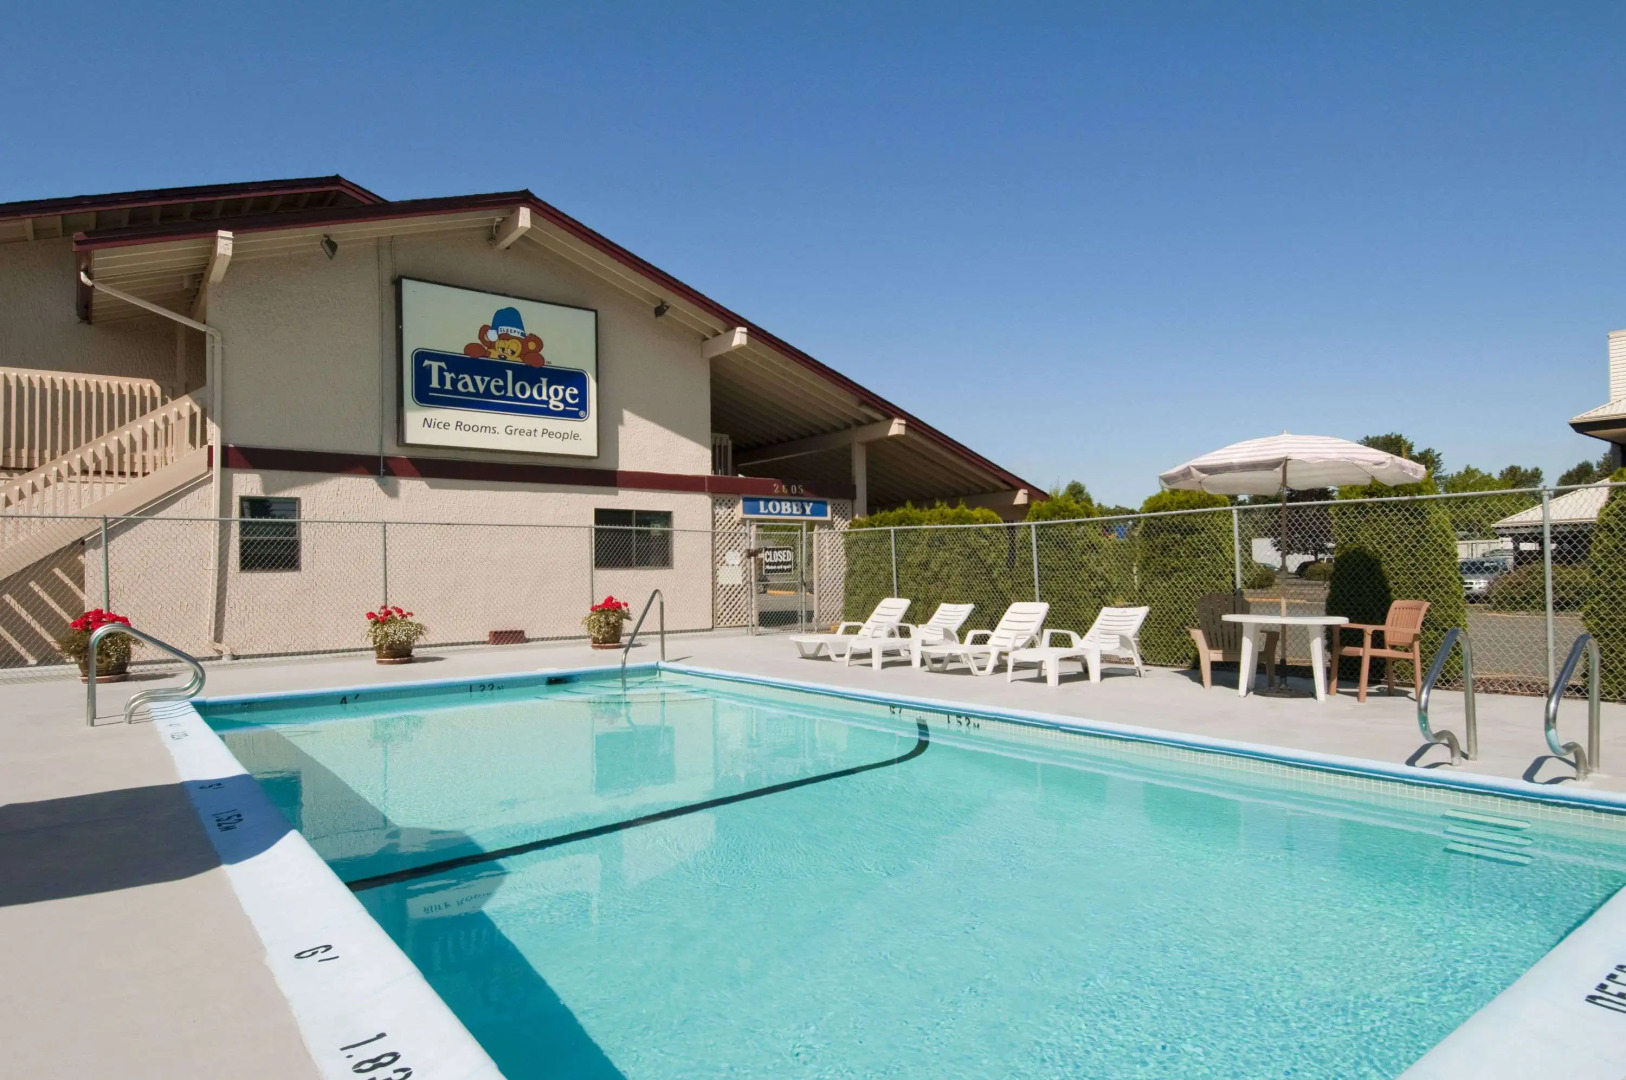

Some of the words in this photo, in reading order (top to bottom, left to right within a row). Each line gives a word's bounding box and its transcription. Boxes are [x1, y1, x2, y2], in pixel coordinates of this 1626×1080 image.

[499, 327, 521, 335] SLEEPY
[422, 359, 579, 411] Travelodge
[422, 417, 451, 430] Nice
[454, 420, 500, 435] Rooms.
[504, 425, 537, 438] Great
[541, 428, 582, 442] People.
[759, 500, 813, 515] LOBBY
[764, 550, 792, 562] CLOSED
